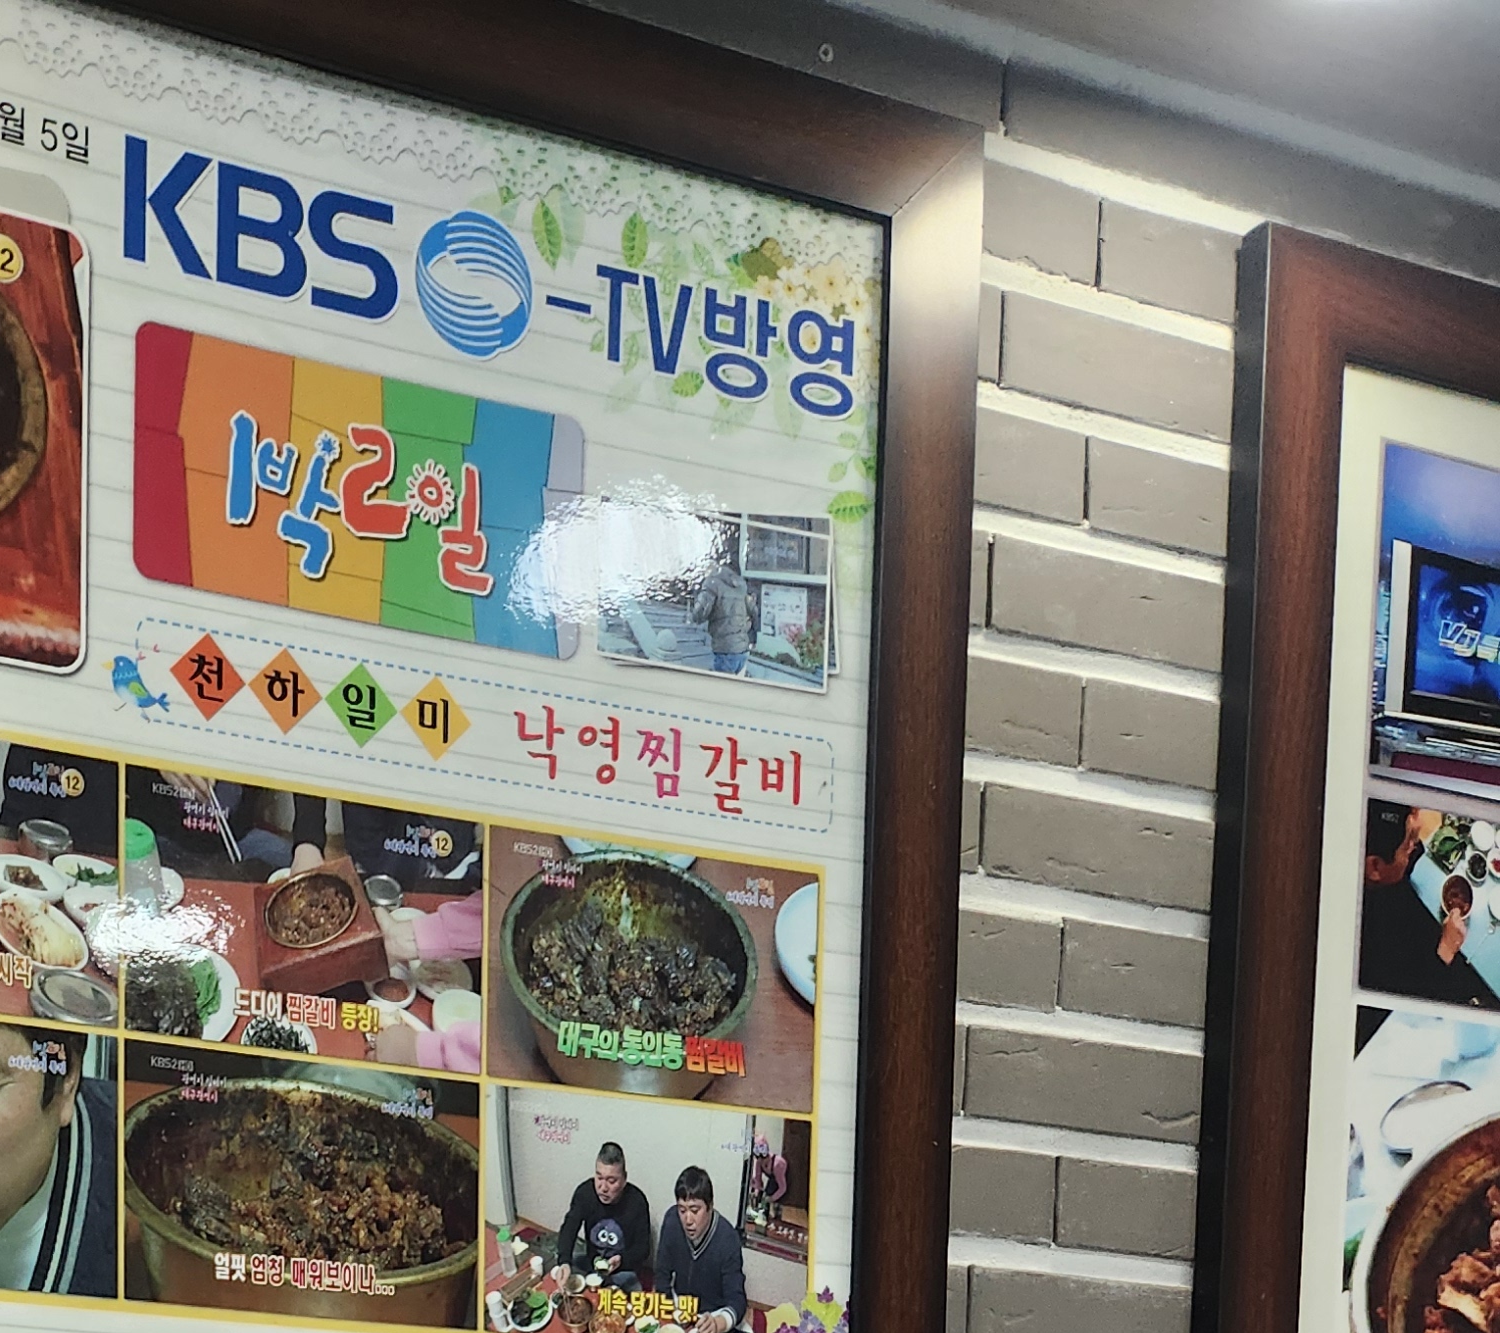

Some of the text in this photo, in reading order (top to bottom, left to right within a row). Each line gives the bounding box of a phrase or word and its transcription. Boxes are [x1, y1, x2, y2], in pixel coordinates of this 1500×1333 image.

[40, 117, 90, 165] 5일
[123, 134, 400, 323] KBS
[63, 768, 81, 792] 12
[233, 988, 284, 1021] 드디어
[286, 991, 337, 1030] 찜갈비
[557, 1020, 747, 1077] 대구의 동인동 찜갈비
[213, 1251, 247, 1282] 얼핏
[250, 1253, 284, 1286] 엄청
[596, 1287, 629, 1316] 계속
[630, 1289, 674, 1319] 당기는
